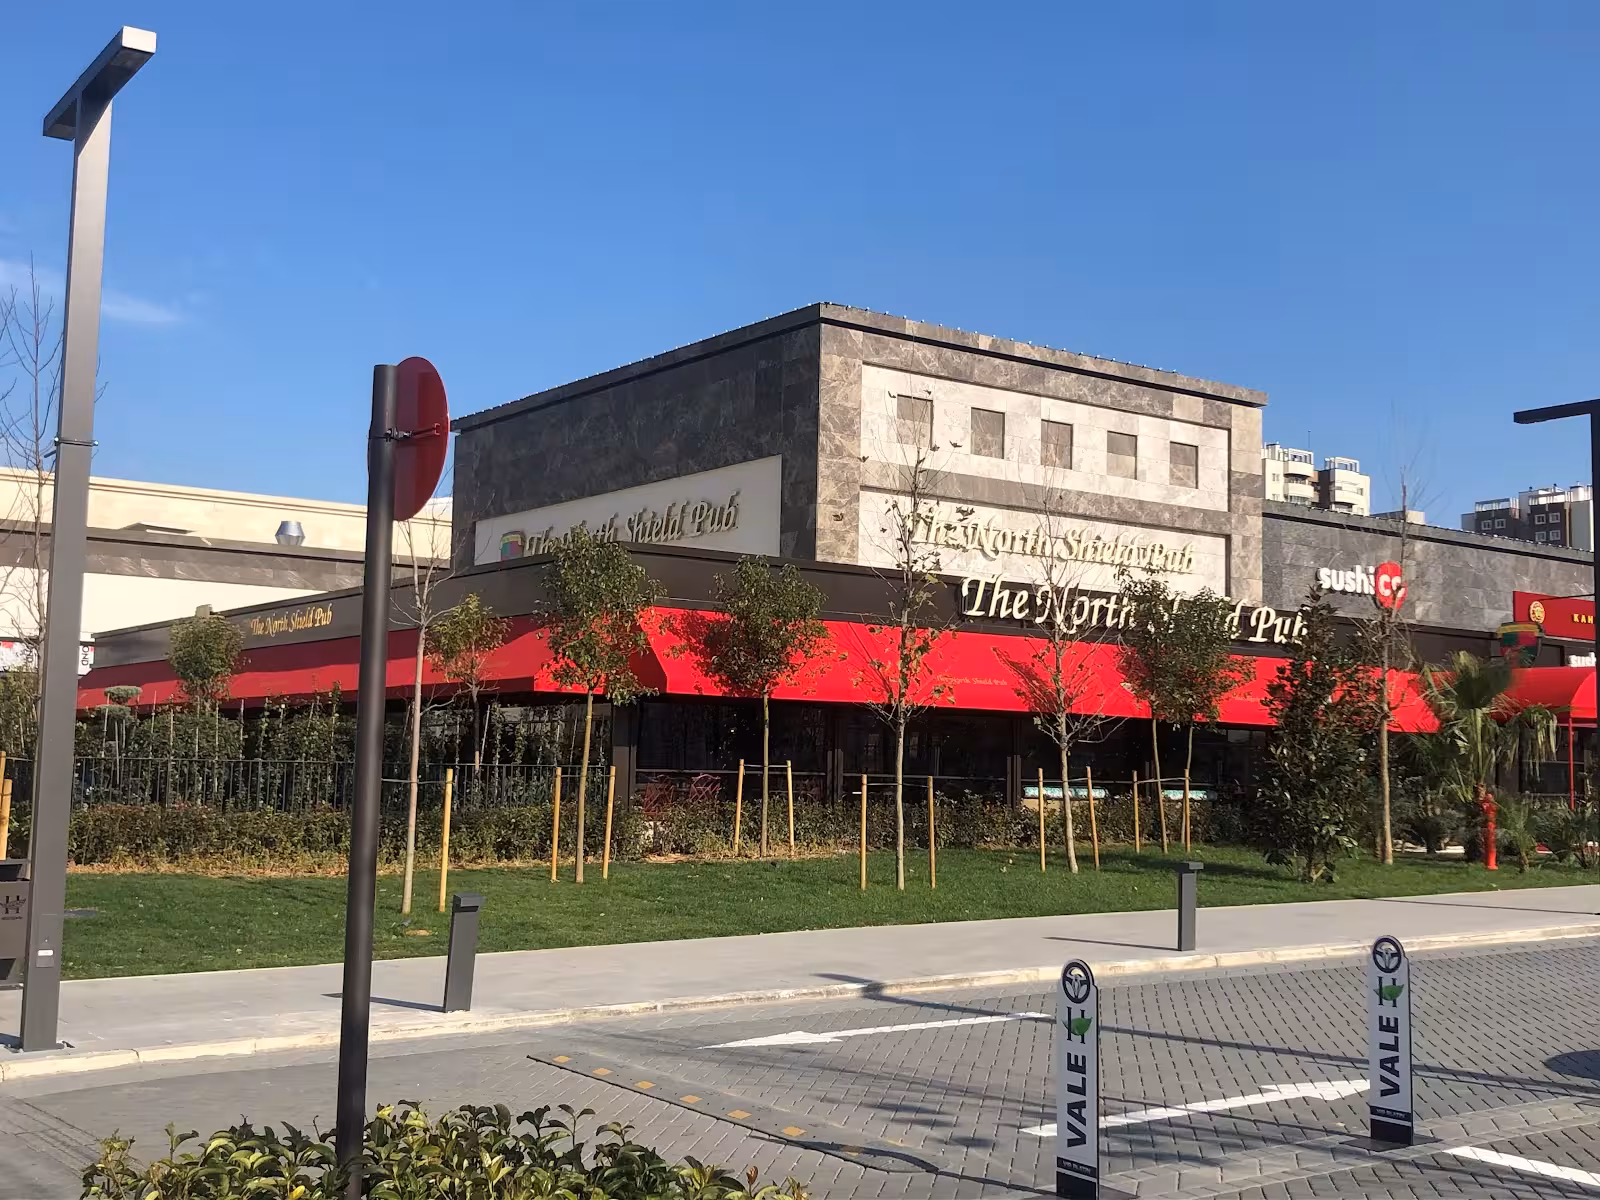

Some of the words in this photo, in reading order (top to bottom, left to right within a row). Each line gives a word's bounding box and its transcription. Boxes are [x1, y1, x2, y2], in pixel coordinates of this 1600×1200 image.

[626, 502, 688, 543] Shield
[683, 491, 737, 538] Pub
[963, 515, 1052, 559] North
[1056, 526, 1146, 567] Shield
[1144, 541, 1196, 572] Pub
[251, 616, 265, 636] The
[265, 611, 289, 637] North
[288, 606, 315, 632] Shield
[314, 603, 333, 627] Pub
[962, 573, 1029, 620] The
